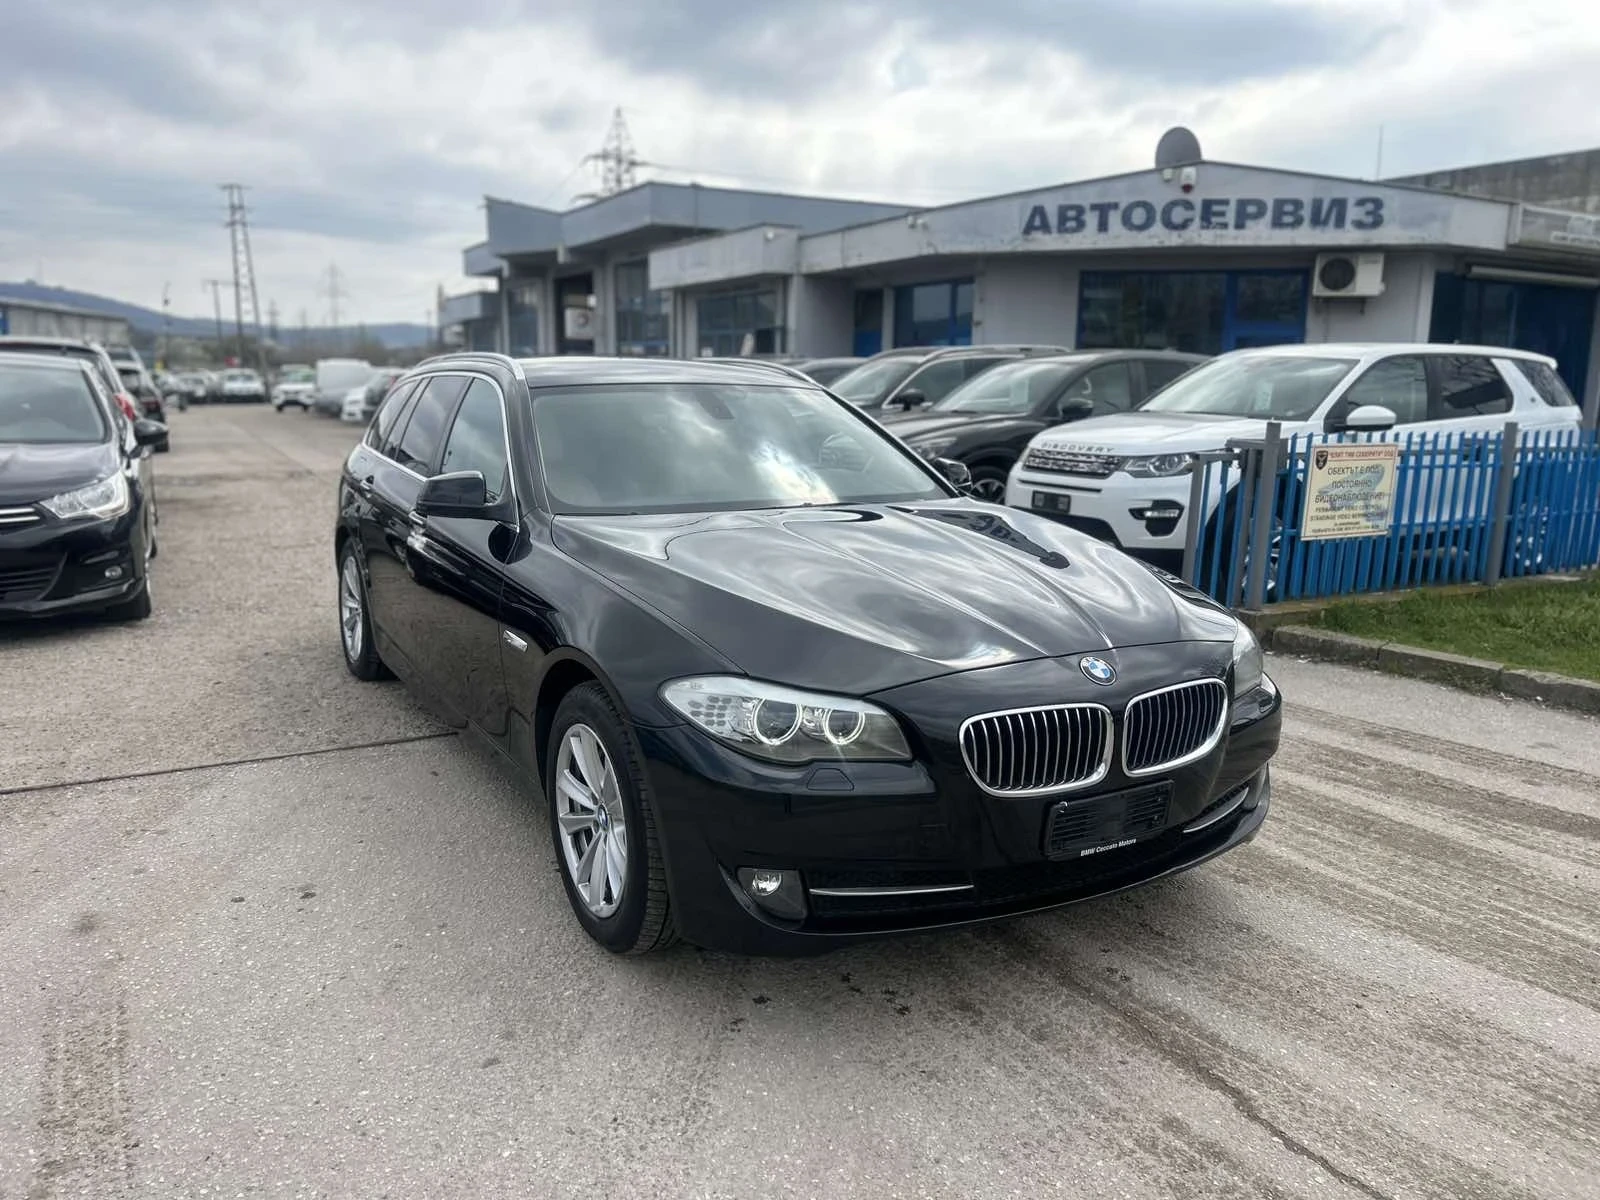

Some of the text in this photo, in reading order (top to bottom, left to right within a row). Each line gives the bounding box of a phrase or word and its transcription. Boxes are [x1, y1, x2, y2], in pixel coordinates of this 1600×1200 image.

[1023, 196, 1385, 236] АВТОСЕРВИЗ
[1041, 442, 1114, 453] DISCOVERY
[1080, 848, 1096, 857] BMW
